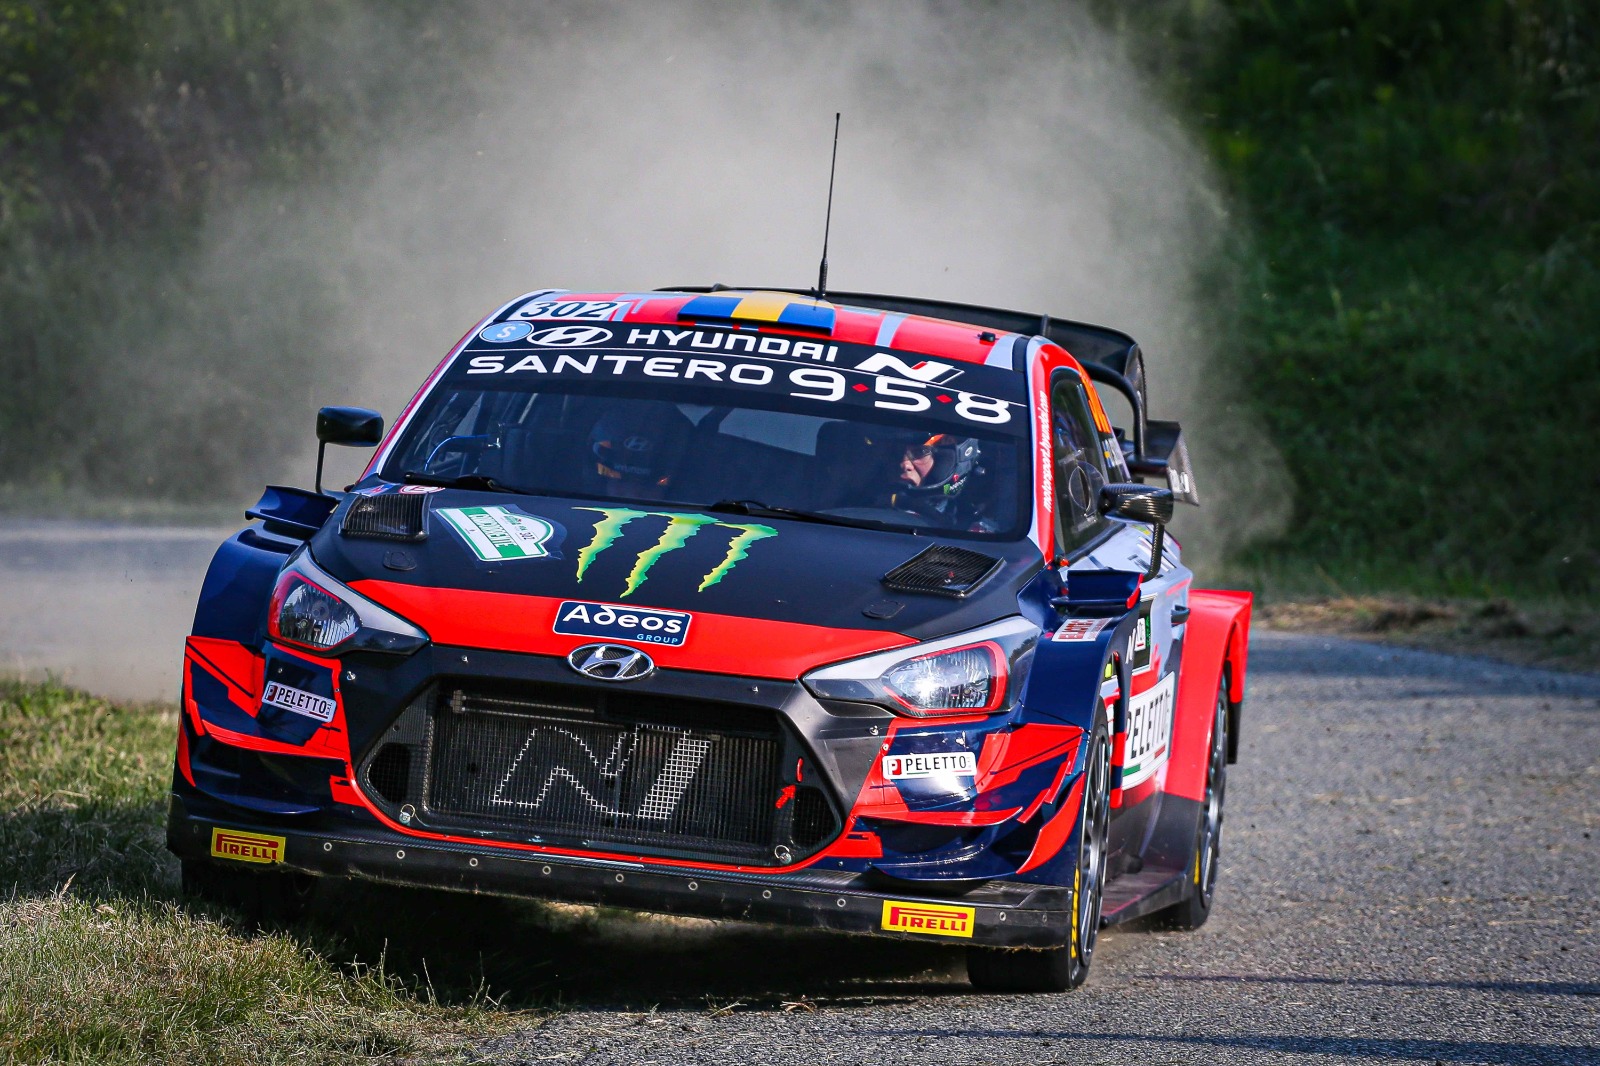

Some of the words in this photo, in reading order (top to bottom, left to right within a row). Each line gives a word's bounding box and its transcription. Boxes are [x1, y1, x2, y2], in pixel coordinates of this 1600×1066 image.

[520, 301, 618, 318] 302
[626, 328, 839, 363] HYUNDAI
[466, 354, 774, 385] SANTERO
[562, 604, 687, 634] Adeos
[636, 633, 679, 645] GROUP
[277, 688, 328, 714] PELETTO
[905, 756, 967, 771] PELETTO
[216, 833, 279, 861] PIRELLI
[889, 906, 969, 932] PIRELLI
